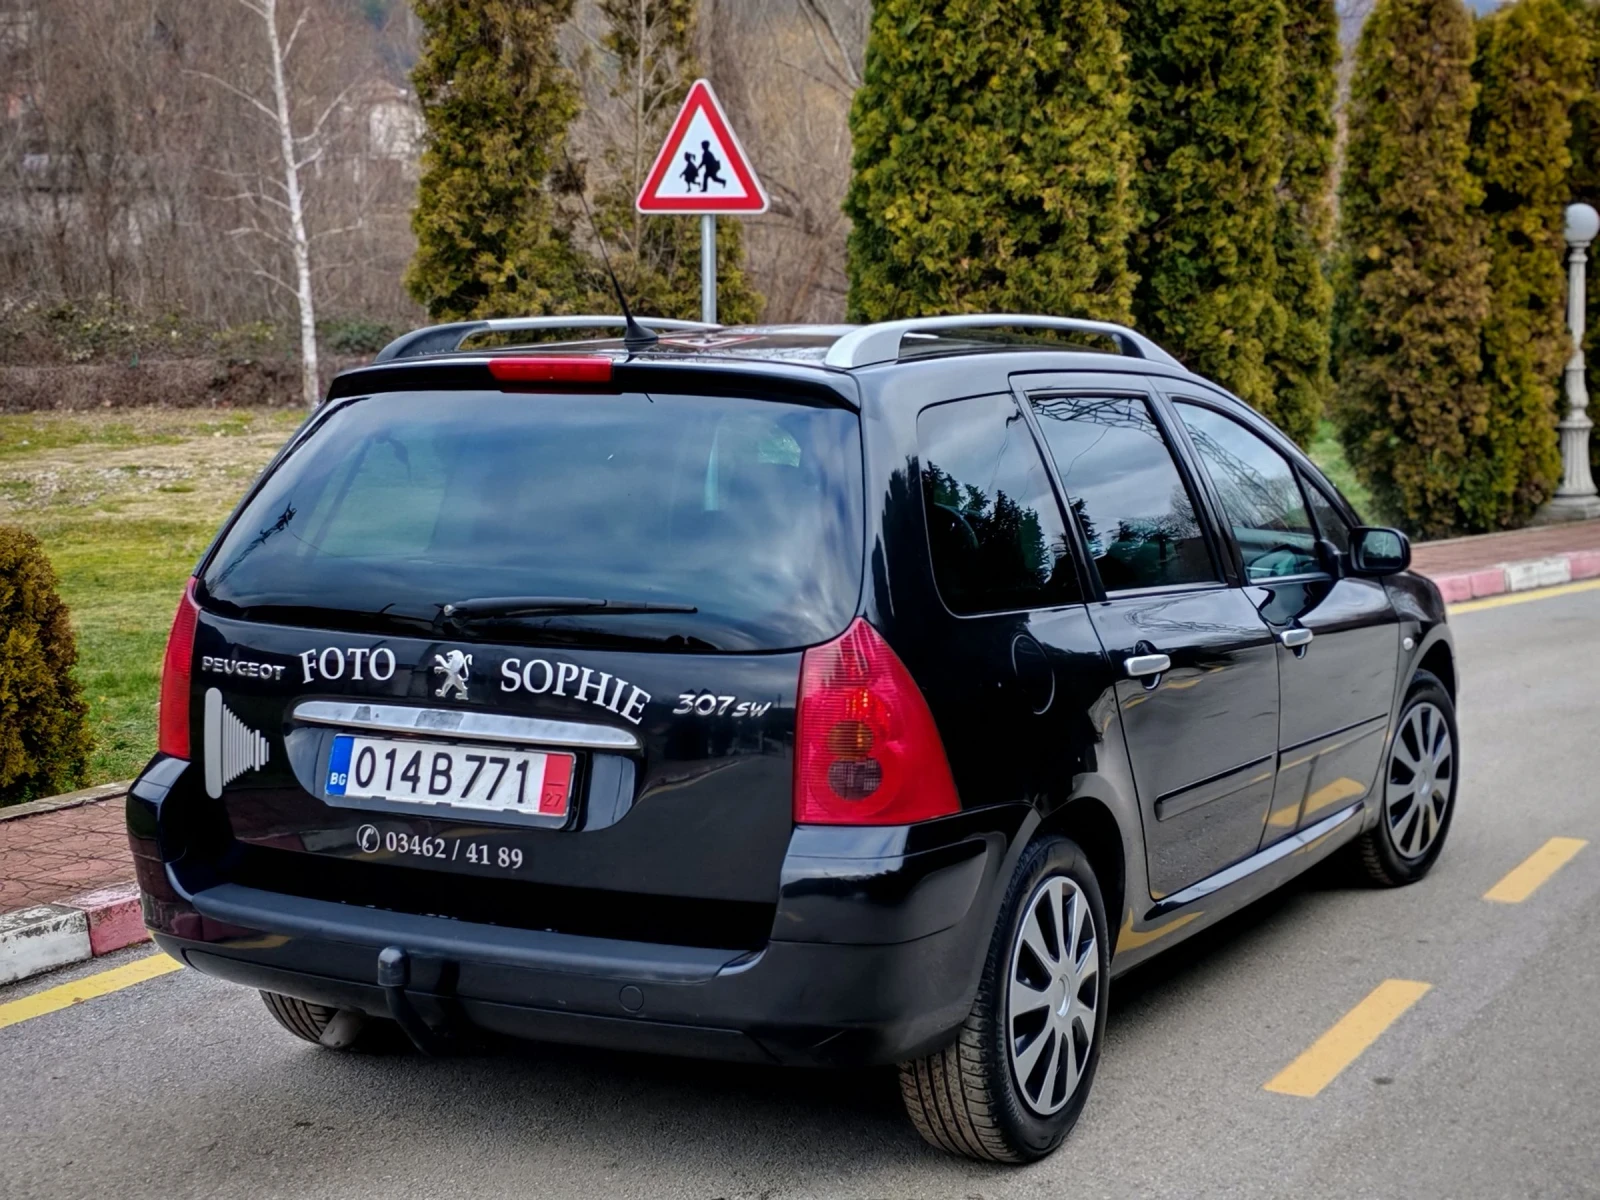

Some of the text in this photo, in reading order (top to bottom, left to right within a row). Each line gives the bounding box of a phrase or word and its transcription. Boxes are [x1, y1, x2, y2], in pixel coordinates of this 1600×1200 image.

[202, 656, 285, 681] PEUGEOT
[300, 647, 652, 725] FOTO SOPHIE
[672, 694, 735, 716] 307
[330, 772, 347, 786] BG
[355, 746, 530, 804] 014B771
[385, 831, 447, 858] 03462
[466, 843, 491, 865] 41
[498, 847, 523, 869] 89
